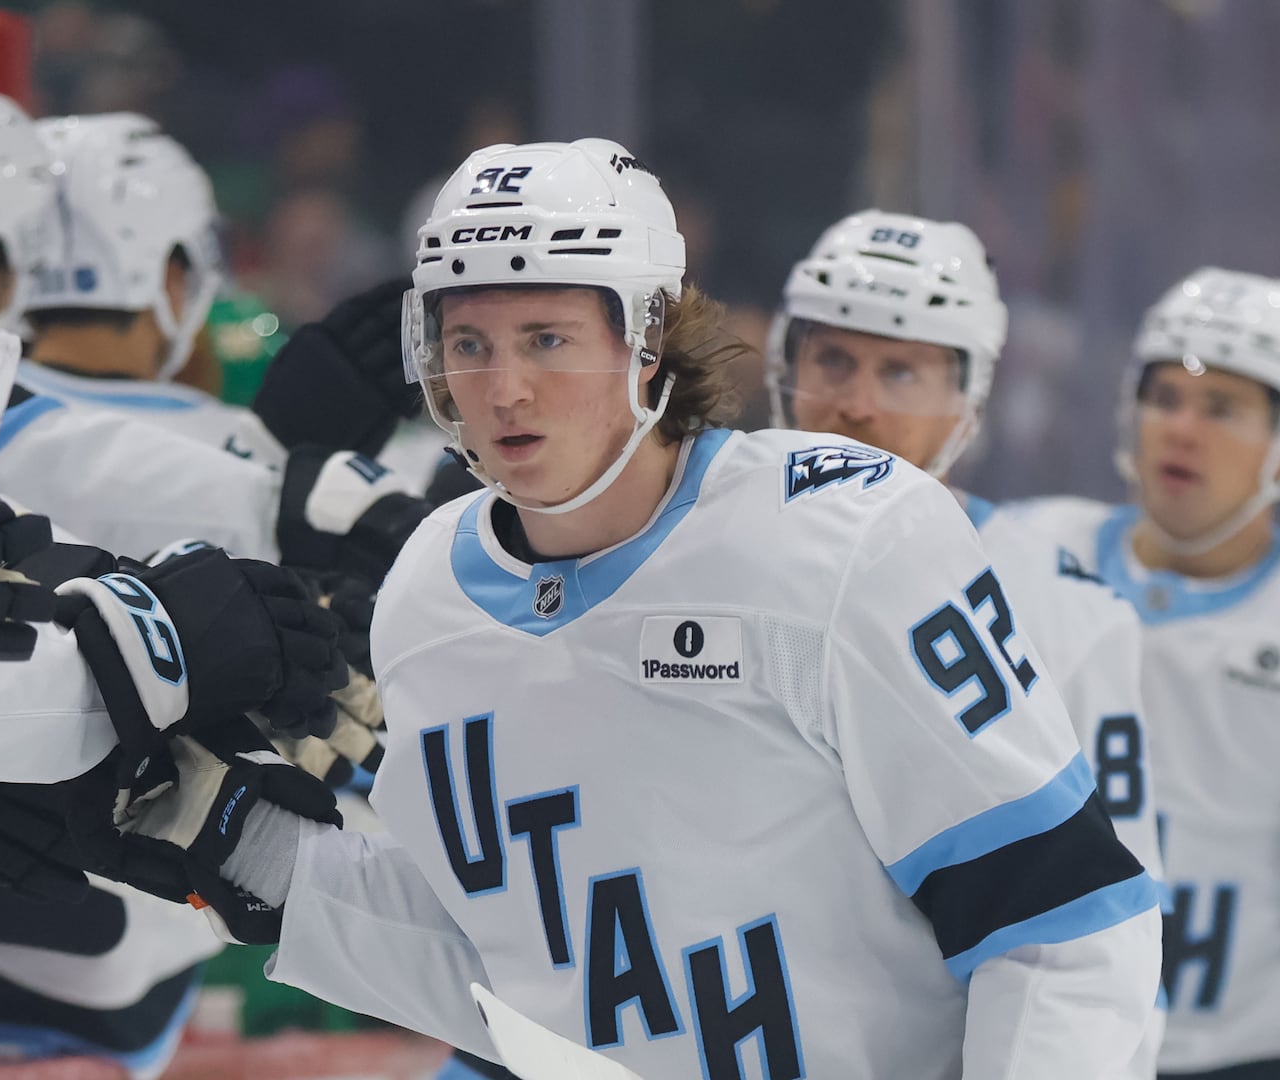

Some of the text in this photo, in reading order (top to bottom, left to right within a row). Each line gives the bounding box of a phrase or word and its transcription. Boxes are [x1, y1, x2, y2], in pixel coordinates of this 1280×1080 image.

[471, 166, 533, 195] 92
[451, 225, 533, 244] CCM
[640, 351, 657, 362] CCM
[907, 565, 1040, 740] 92
[641, 659, 740, 680] 1Password
[246, 902, 273, 912] CM
